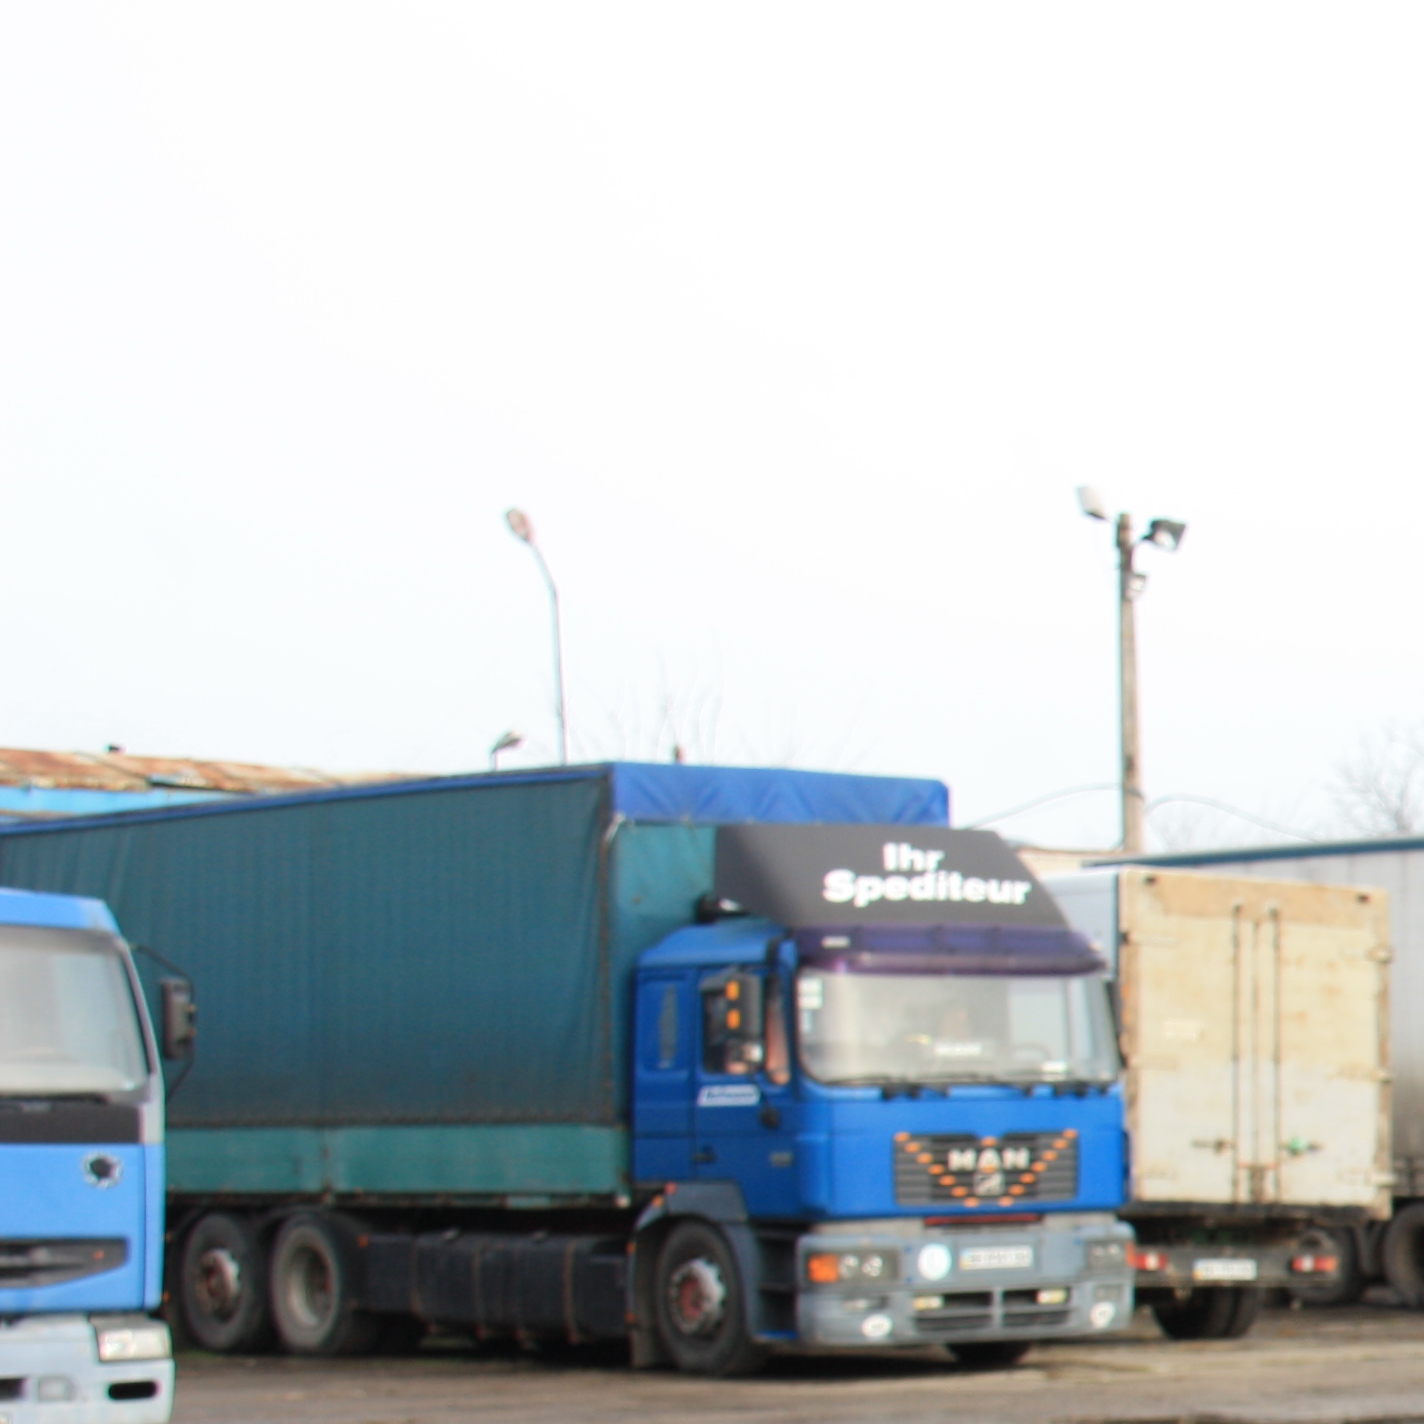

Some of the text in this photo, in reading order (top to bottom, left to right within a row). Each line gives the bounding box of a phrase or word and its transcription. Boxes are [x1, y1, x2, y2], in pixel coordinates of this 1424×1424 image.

[883, 842, 945, 871] Ihr
[823, 869, 1031, 907] Spediteur
[947, 1147, 1030, 1172] MAN
